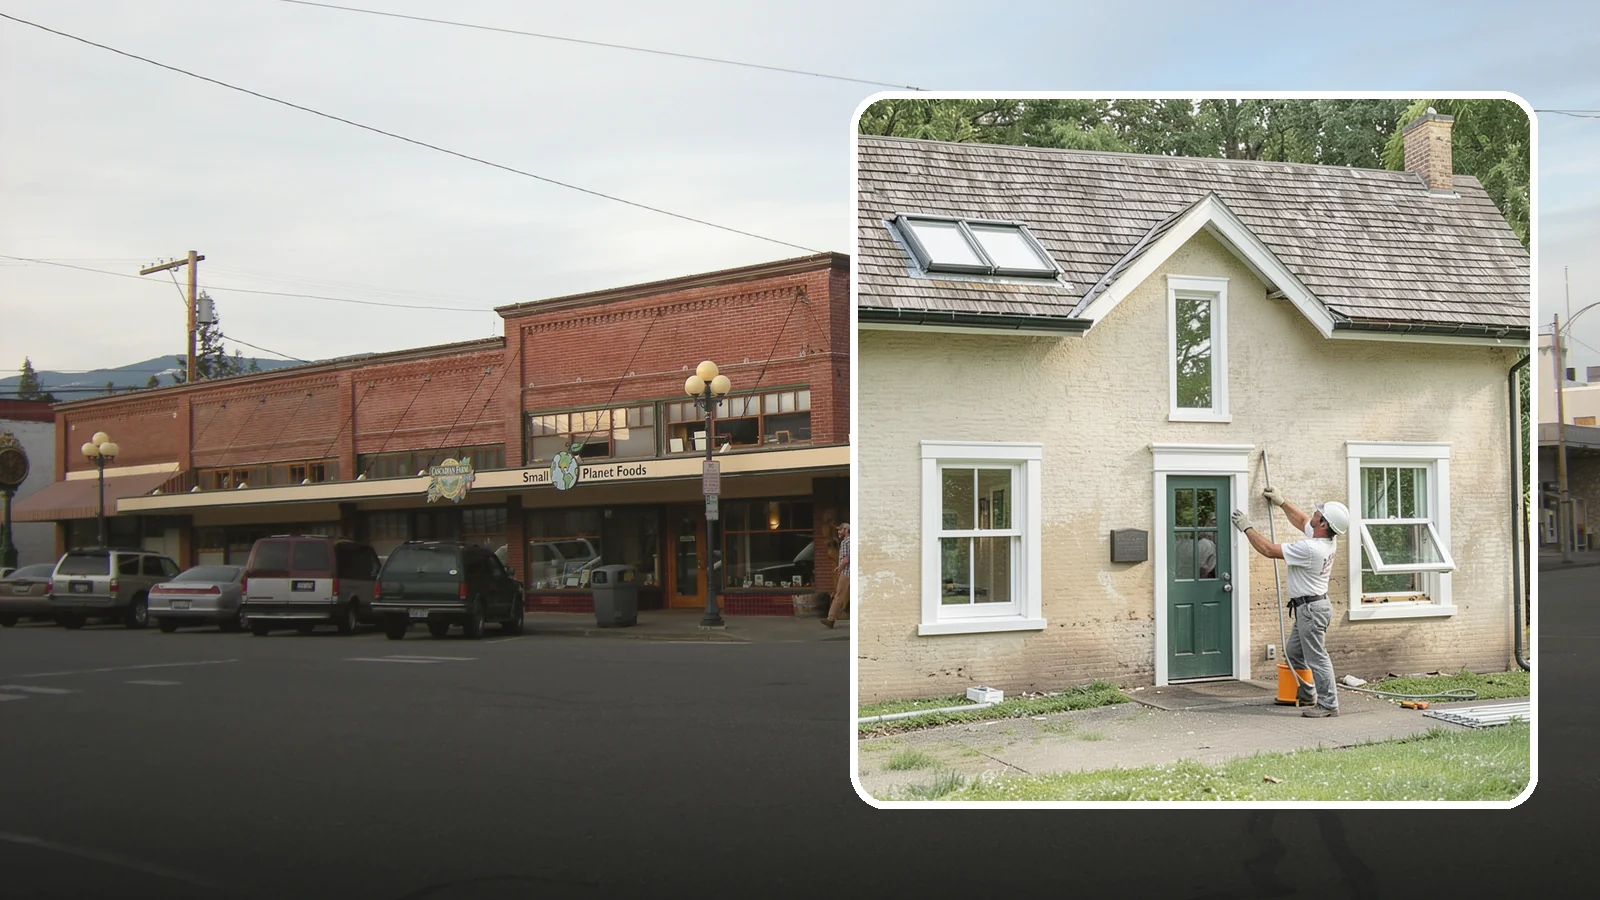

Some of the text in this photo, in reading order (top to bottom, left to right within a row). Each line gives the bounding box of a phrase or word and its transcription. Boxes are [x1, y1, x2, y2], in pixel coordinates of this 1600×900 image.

[523, 464, 647, 483] Small Planet Foods
